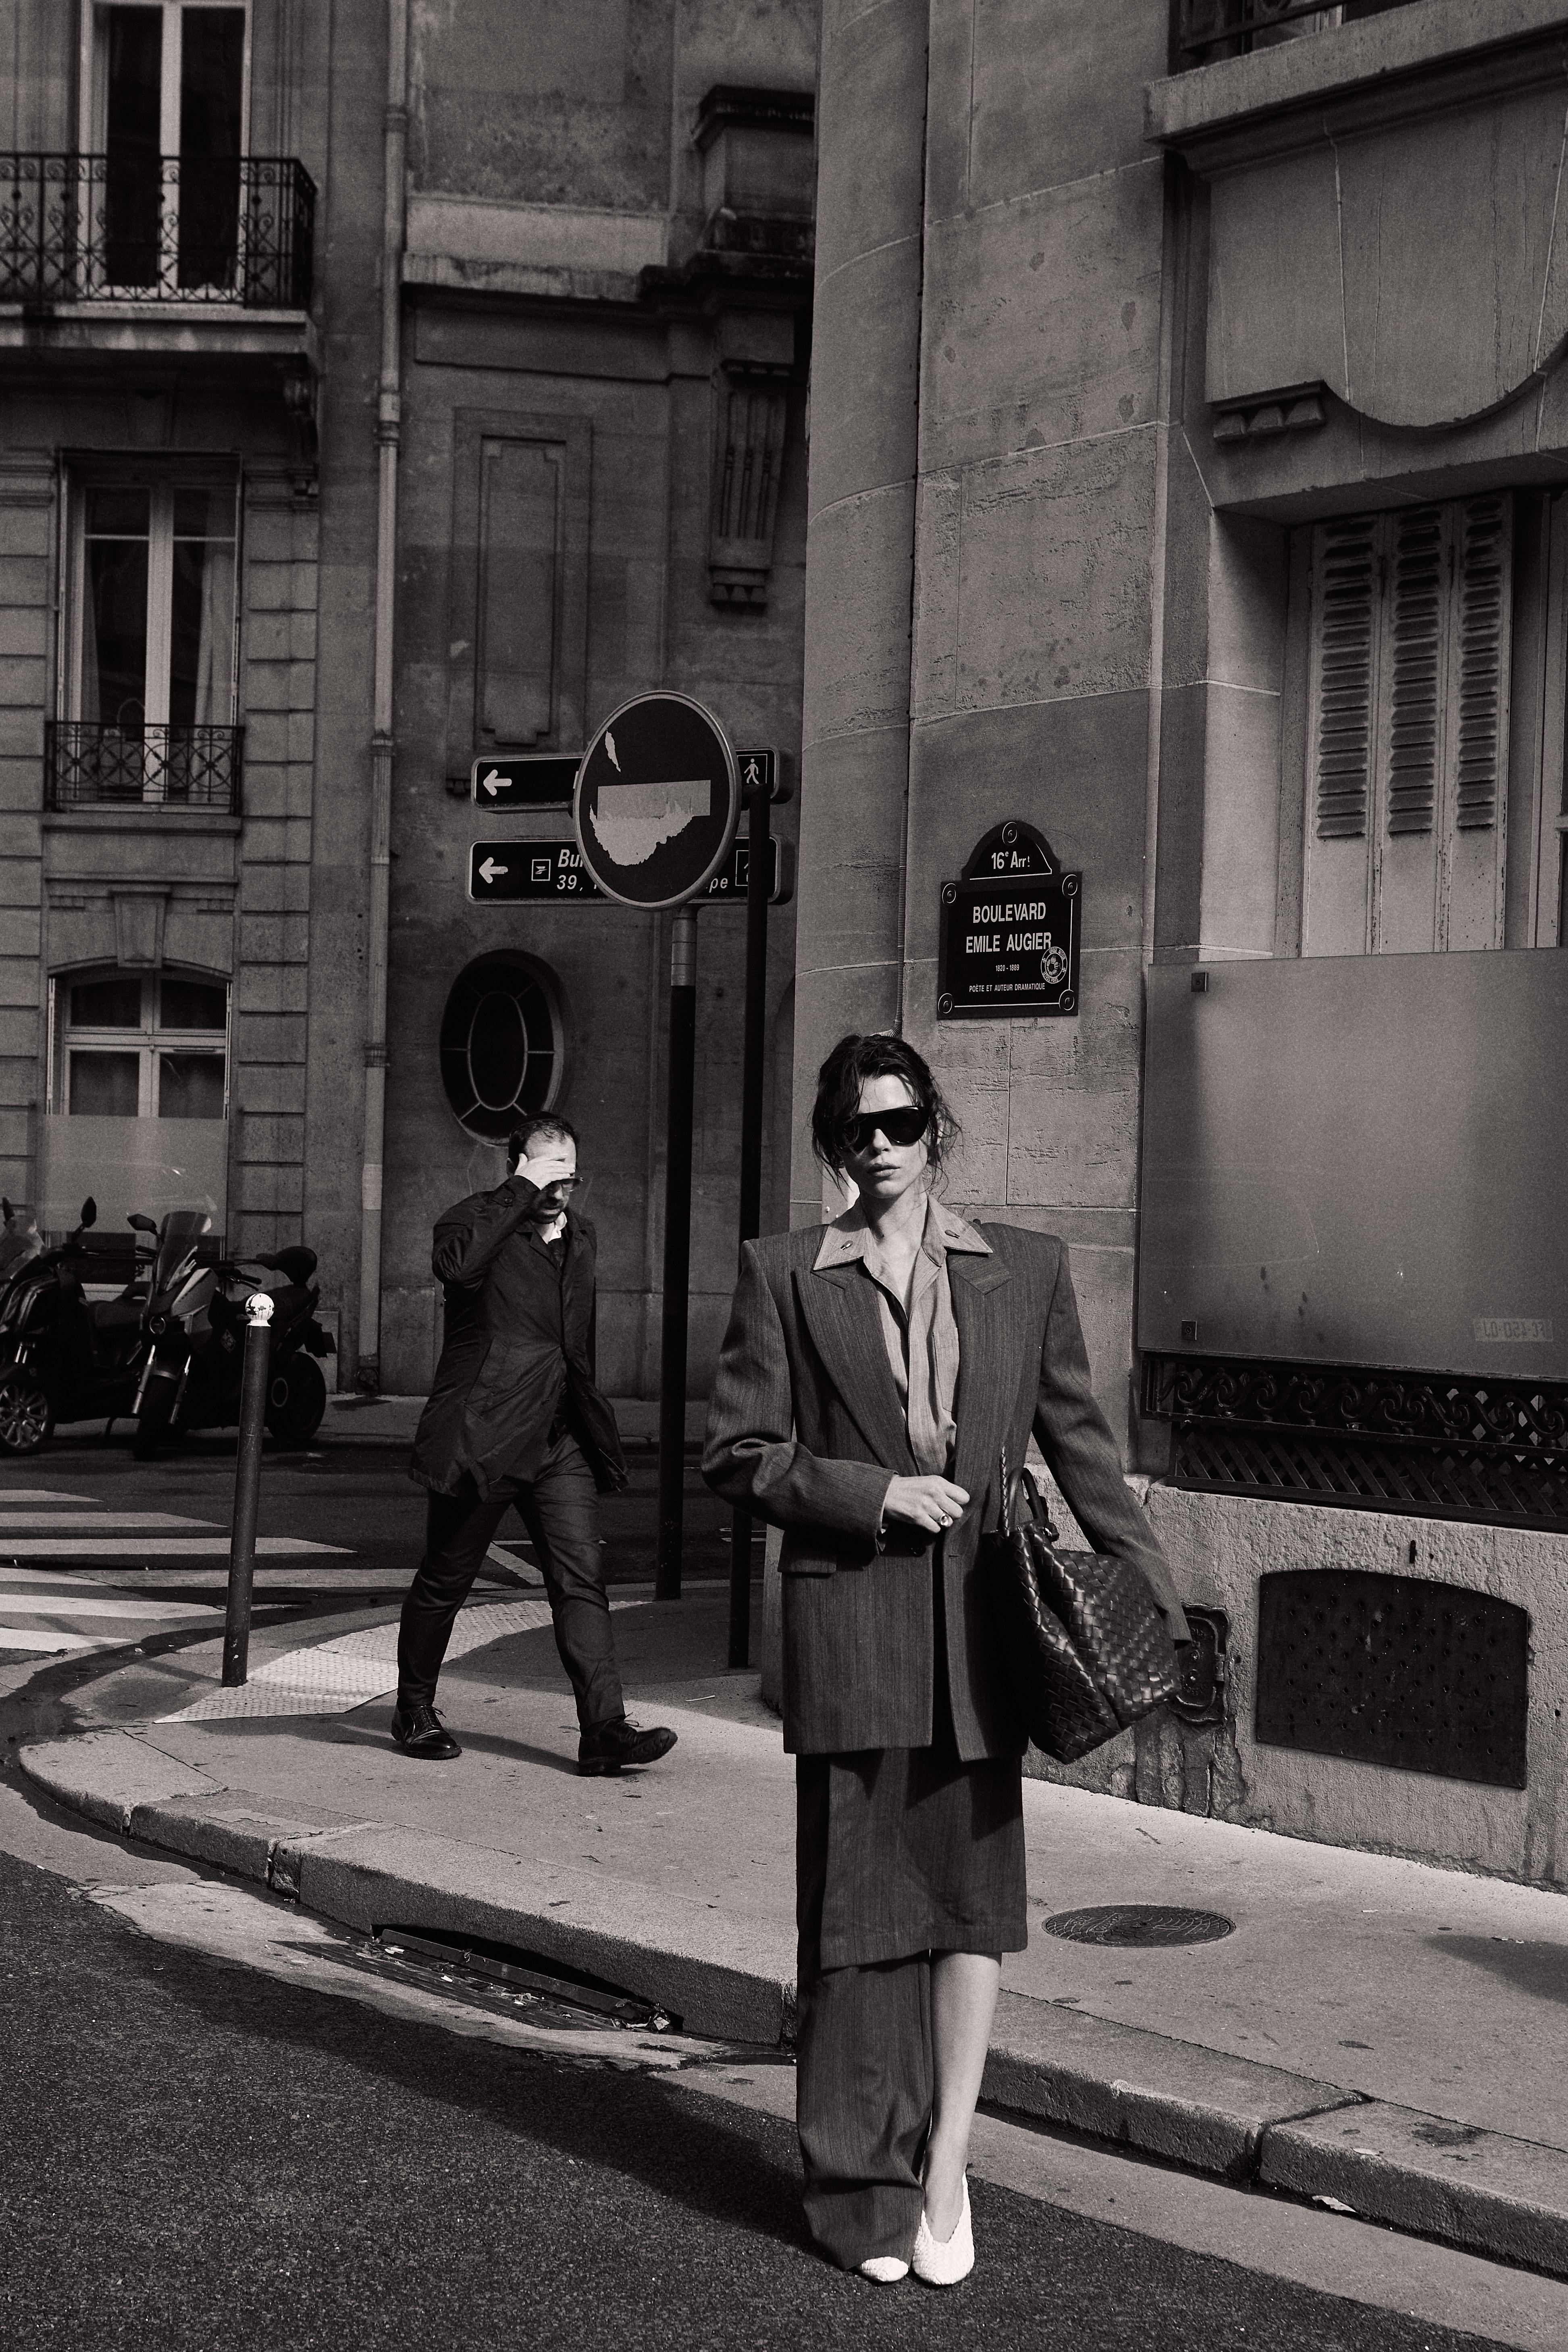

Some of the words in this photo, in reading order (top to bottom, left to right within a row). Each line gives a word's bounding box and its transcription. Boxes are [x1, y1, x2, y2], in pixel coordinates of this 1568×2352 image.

[706, 878, 728, 893] pe
[973, 902, 1046, 923] BOULEVARD
[966, 935, 1000, 953] EMILE
[1006, 932, 1052, 951] AUGIER
[969, 984, 985, 992] POÈTE
[994, 984, 1013, 992] AUTEUR
[1015, 982, 1046, 991] DRAMATIQUE
